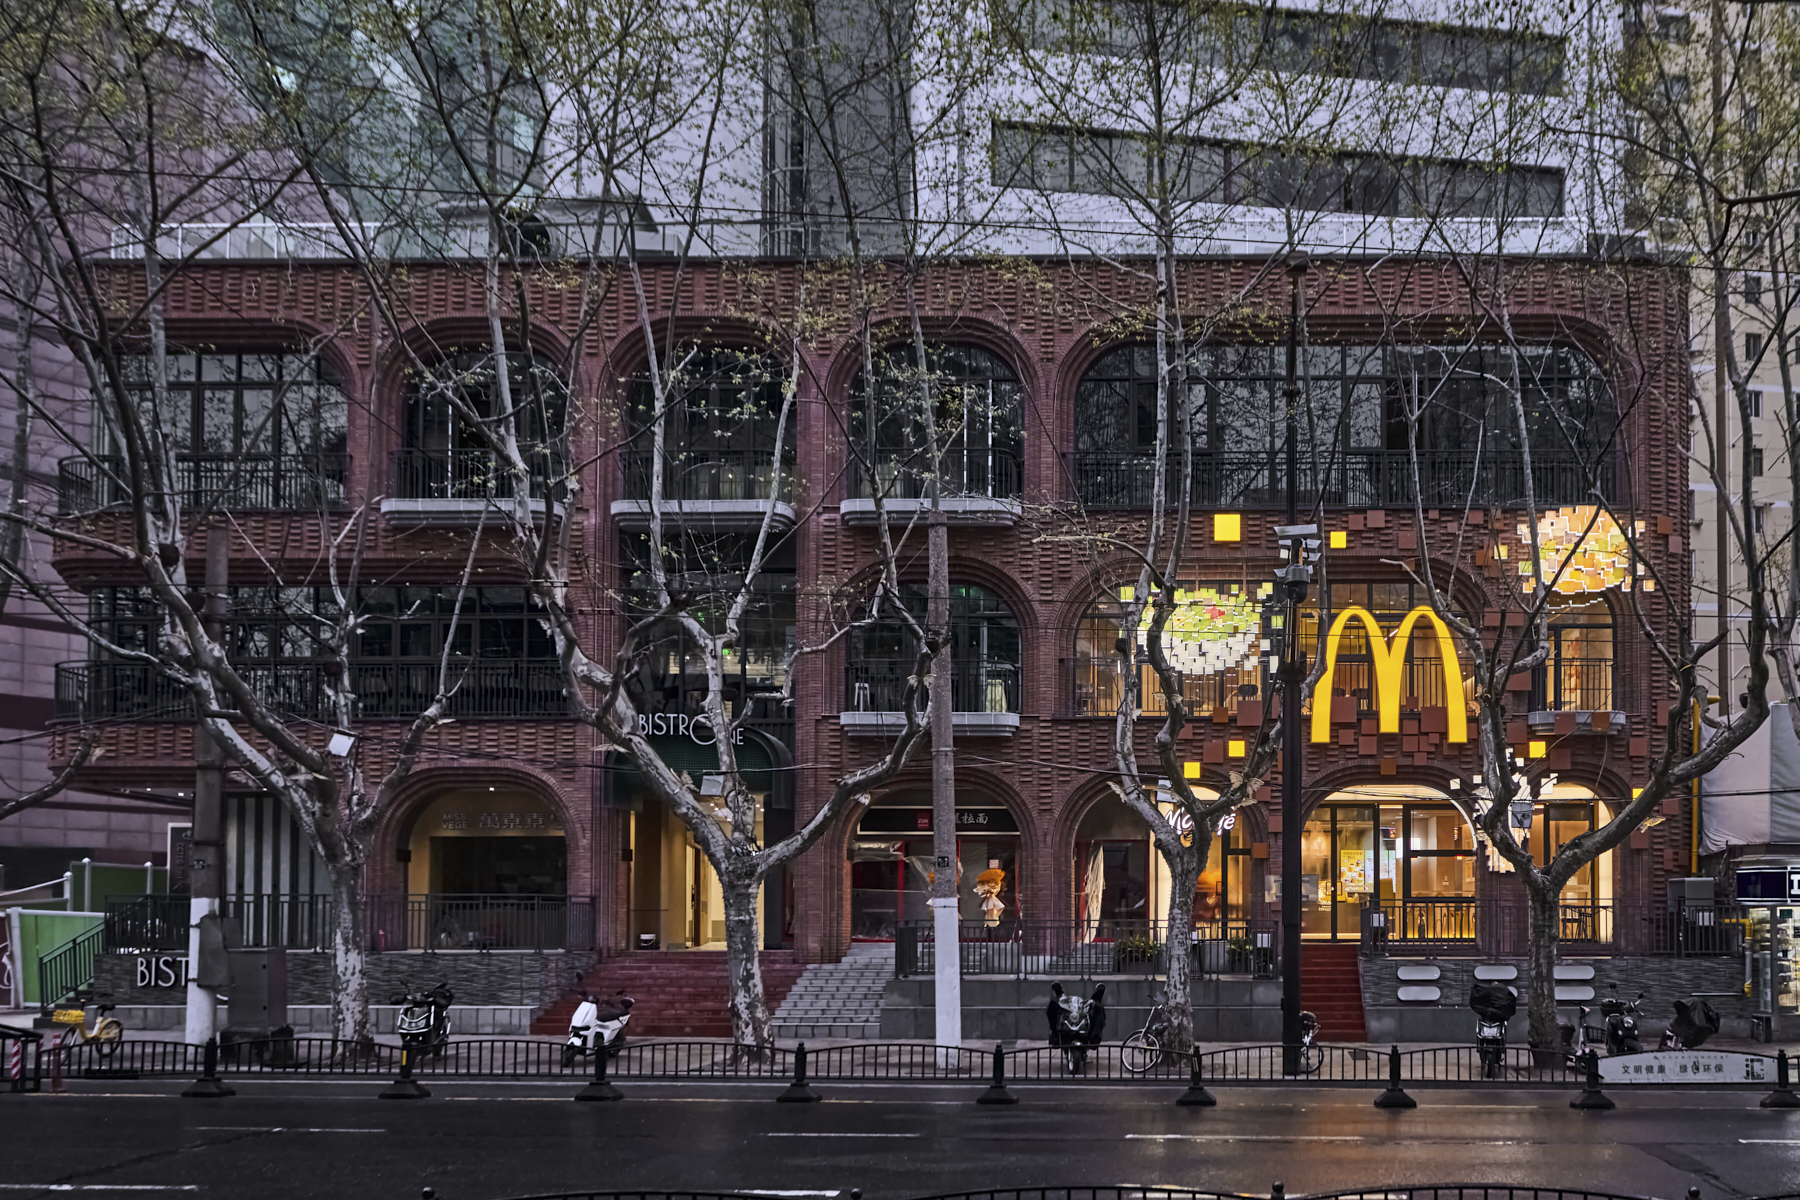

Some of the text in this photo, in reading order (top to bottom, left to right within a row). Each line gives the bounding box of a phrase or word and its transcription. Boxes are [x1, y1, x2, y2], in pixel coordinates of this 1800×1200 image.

[442, 812, 467, 821] MISS
[1165, 805, 1237, 836] Mcfé
[441, 820, 469, 829] VEGE
[136, 956, 190, 987] BIST
[1621, 1063, 1666, 1075] 文明健康
